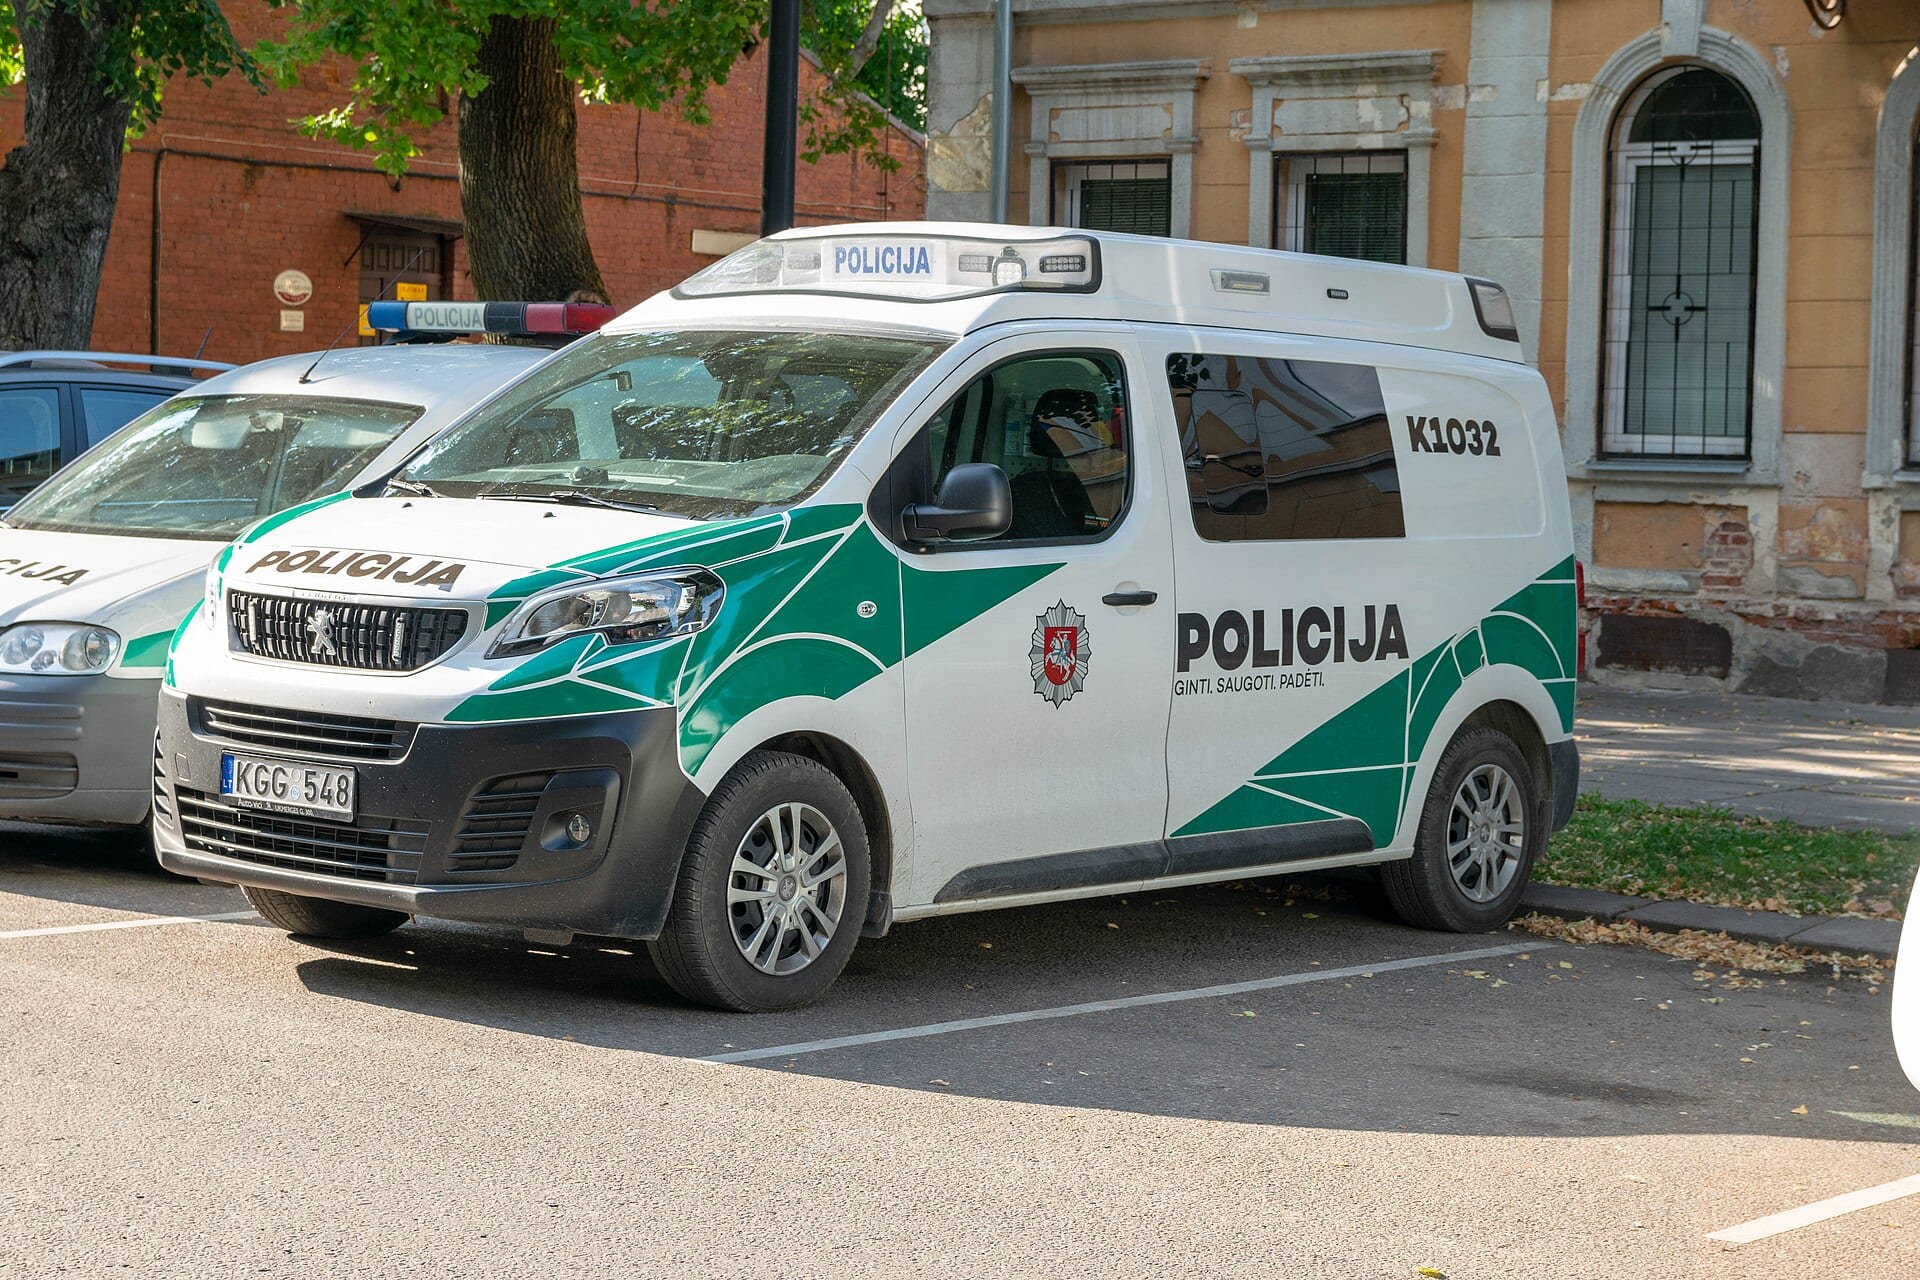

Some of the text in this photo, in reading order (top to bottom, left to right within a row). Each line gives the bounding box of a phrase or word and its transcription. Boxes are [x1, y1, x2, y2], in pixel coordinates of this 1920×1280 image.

[834, 246, 930, 274] POLICIJA
[414, 306, 483, 328] POLICIJA
[1406, 415, 1501, 457] K1032
[245, 550, 467, 592] POLICIJA
[1176, 604, 1410, 673] POLICIJA
[1174, 668, 1325, 696] GINTI. SAUGOTI. PADĖTI.
[236, 760, 350, 808] KGG 548
